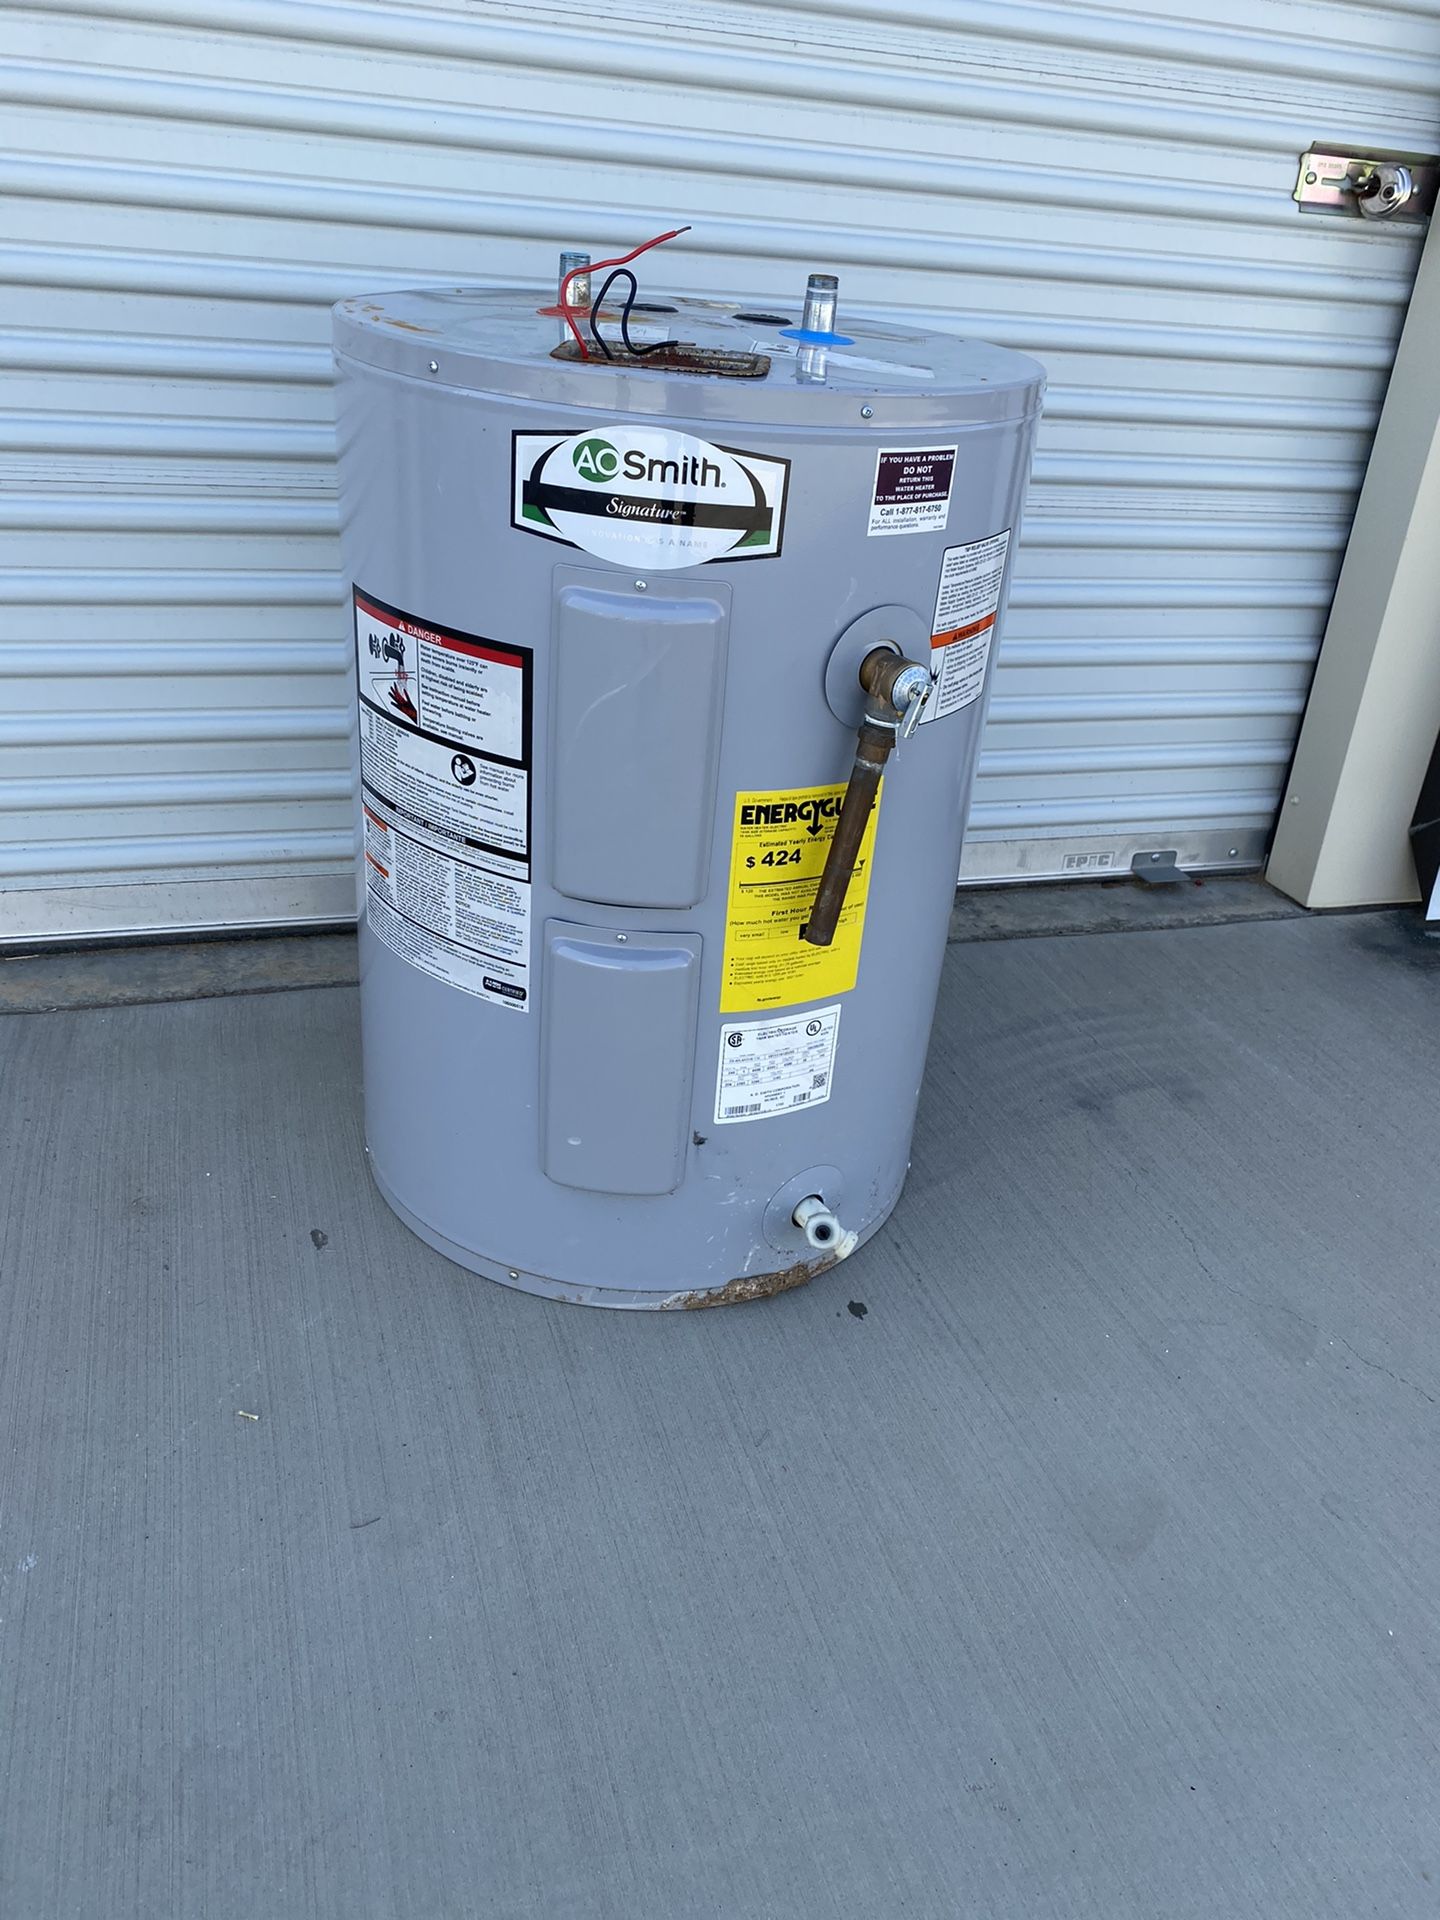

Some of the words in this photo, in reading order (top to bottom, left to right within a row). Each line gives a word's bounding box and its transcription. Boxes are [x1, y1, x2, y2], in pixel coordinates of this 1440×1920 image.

[916, 466, 933, 474] NOT
[606, 497, 682, 520] Signature
[880, 508, 894, 516] Call
[407, 624, 443, 645] DANGER
[759, 840, 787, 848] Estimated
[746, 856, 756, 869] $
[761, 849, 801, 867] 424
